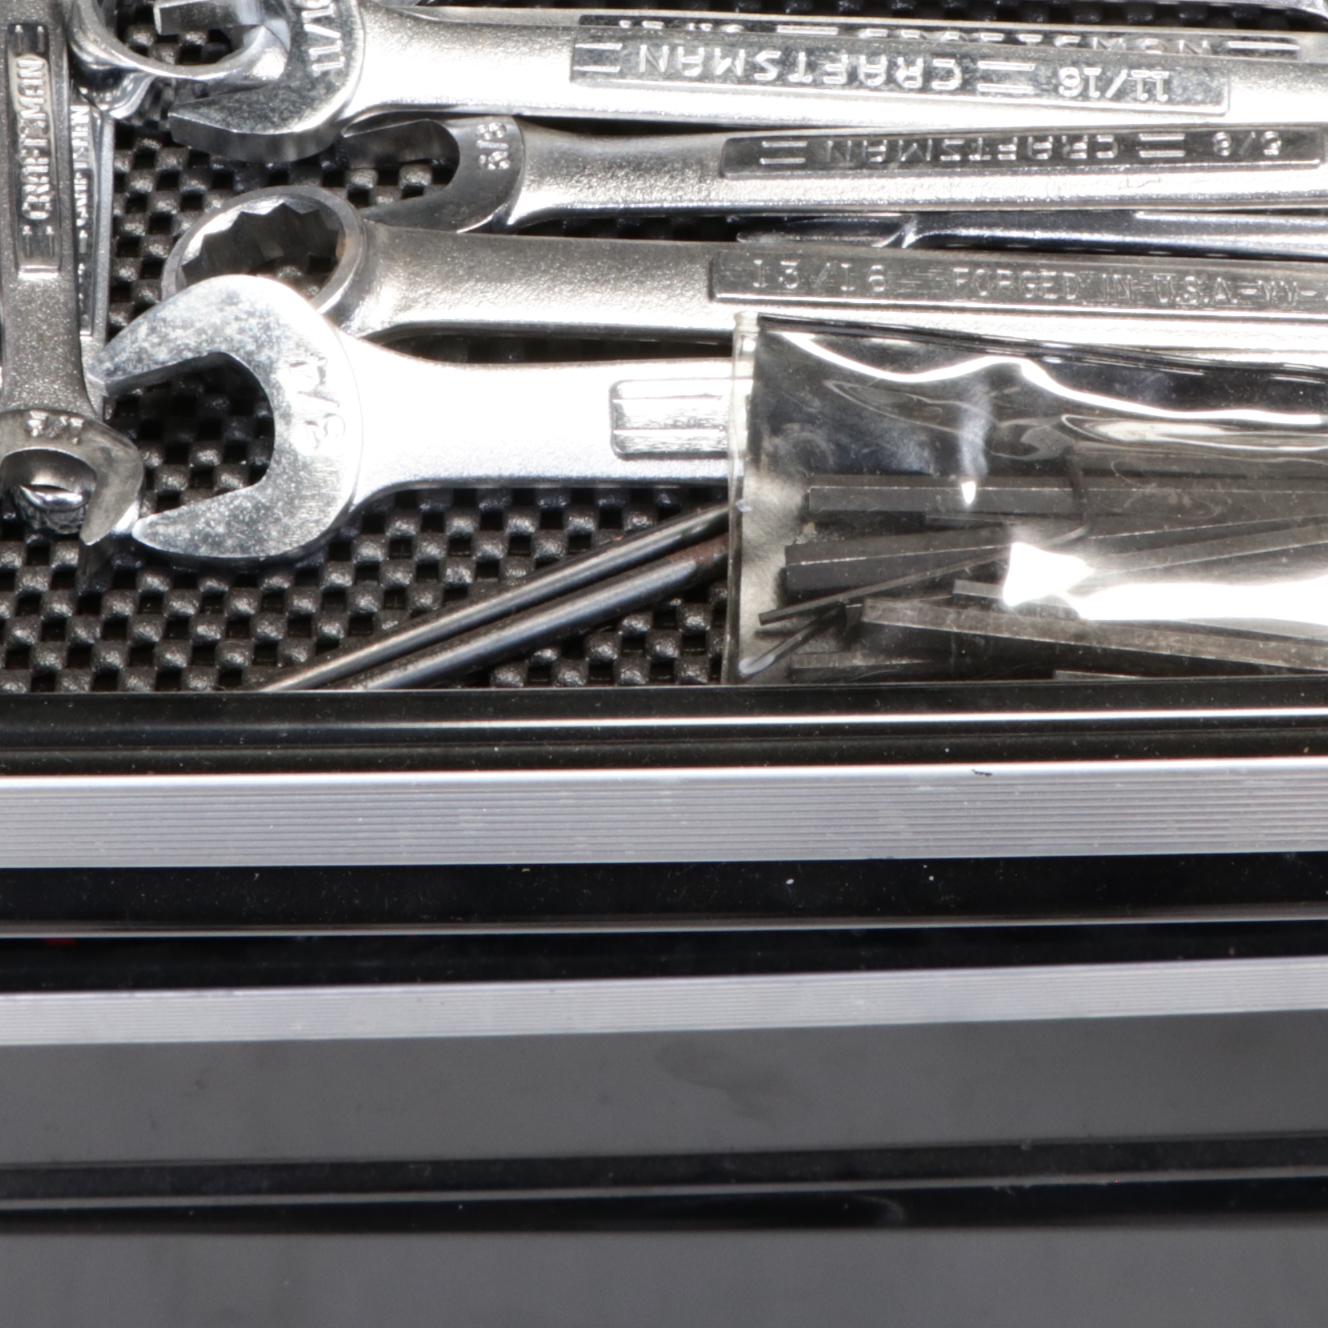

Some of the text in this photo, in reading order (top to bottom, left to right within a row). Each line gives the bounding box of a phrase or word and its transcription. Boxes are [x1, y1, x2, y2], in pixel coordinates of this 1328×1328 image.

[638, 43, 1170, 103] 11/16 CRAFTSMAN
[14, 56, 51, 221] CRAFTSMAN
[825, 133, 1119, 163] CRAFTSMAN
[952, 265, 1083, 300] FORGED
